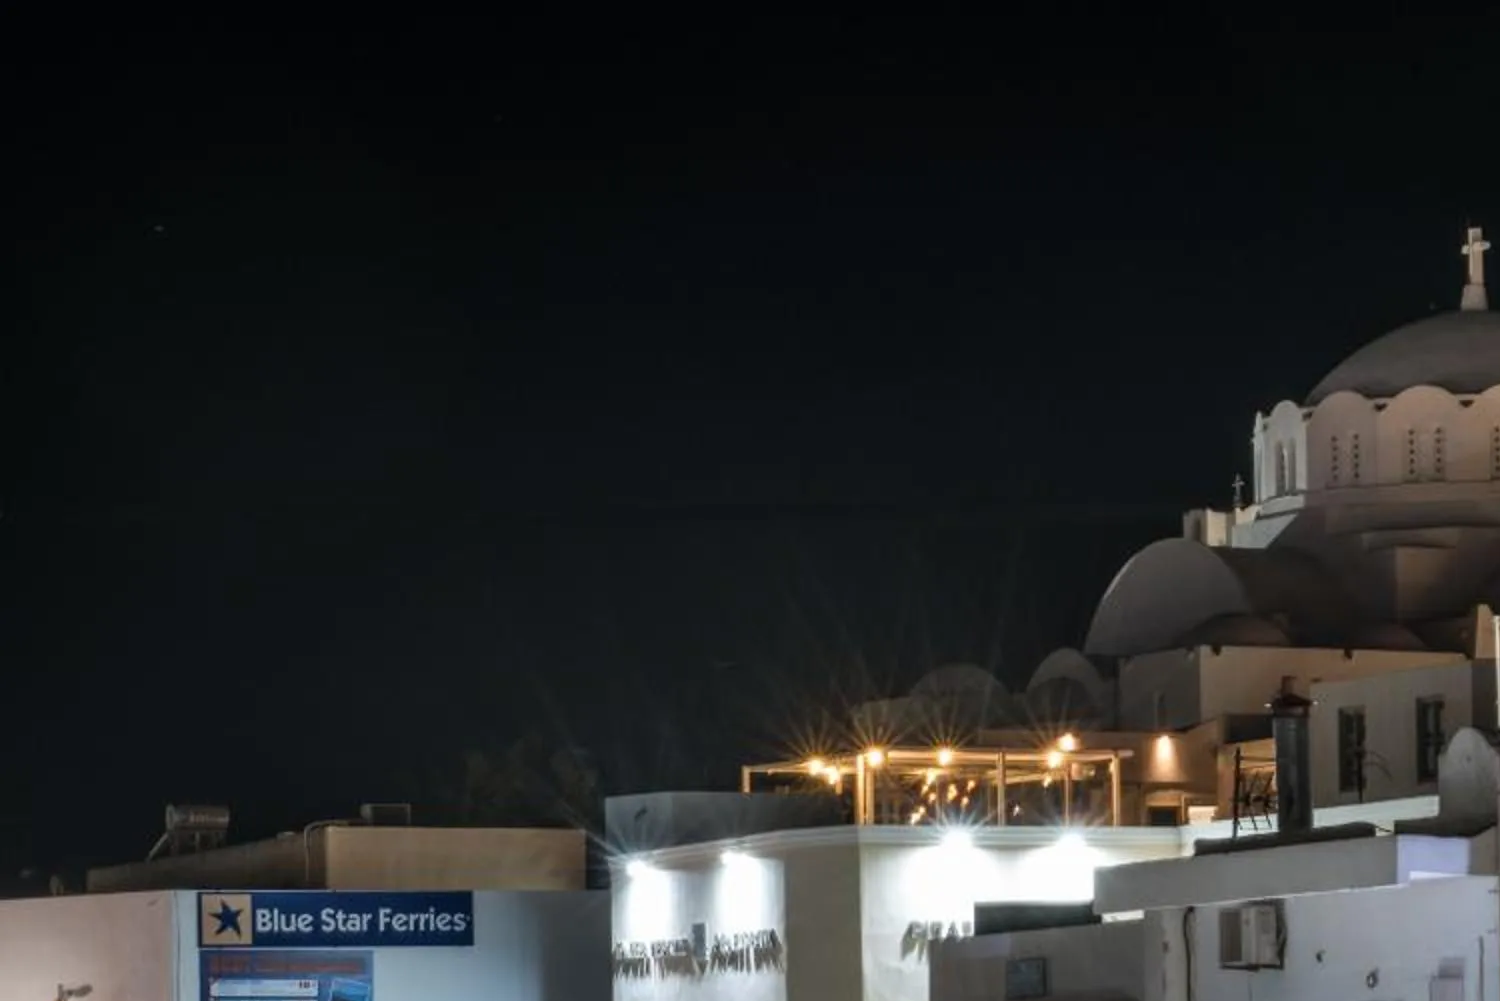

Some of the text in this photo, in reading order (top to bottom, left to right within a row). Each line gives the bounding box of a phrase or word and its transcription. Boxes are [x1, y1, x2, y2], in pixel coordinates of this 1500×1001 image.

[256, 907, 467, 932] Blue Star Ferries
